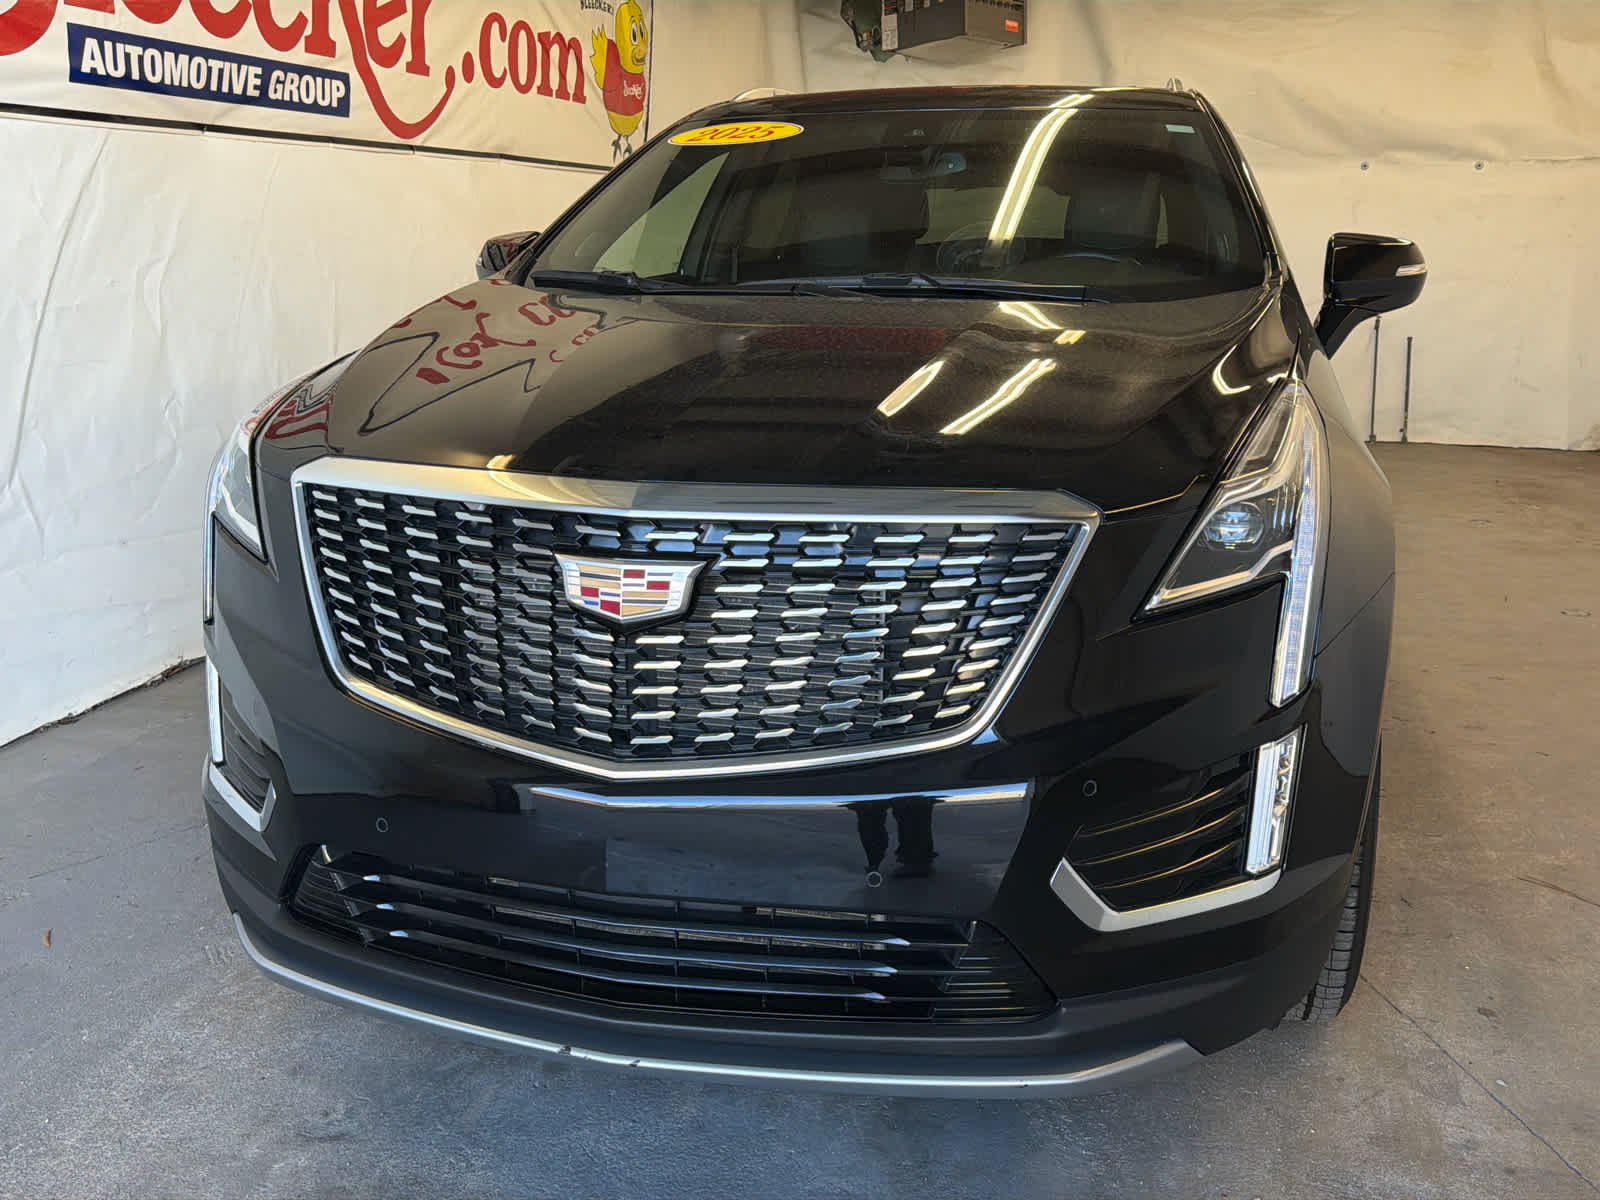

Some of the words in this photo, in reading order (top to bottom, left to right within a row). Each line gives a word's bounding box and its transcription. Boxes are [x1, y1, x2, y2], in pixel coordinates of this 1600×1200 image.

[80, 37, 263, 97] AUTOMOTIVE
[268, 70, 346, 108] GROUP
[686, 125, 786, 143] 2025
